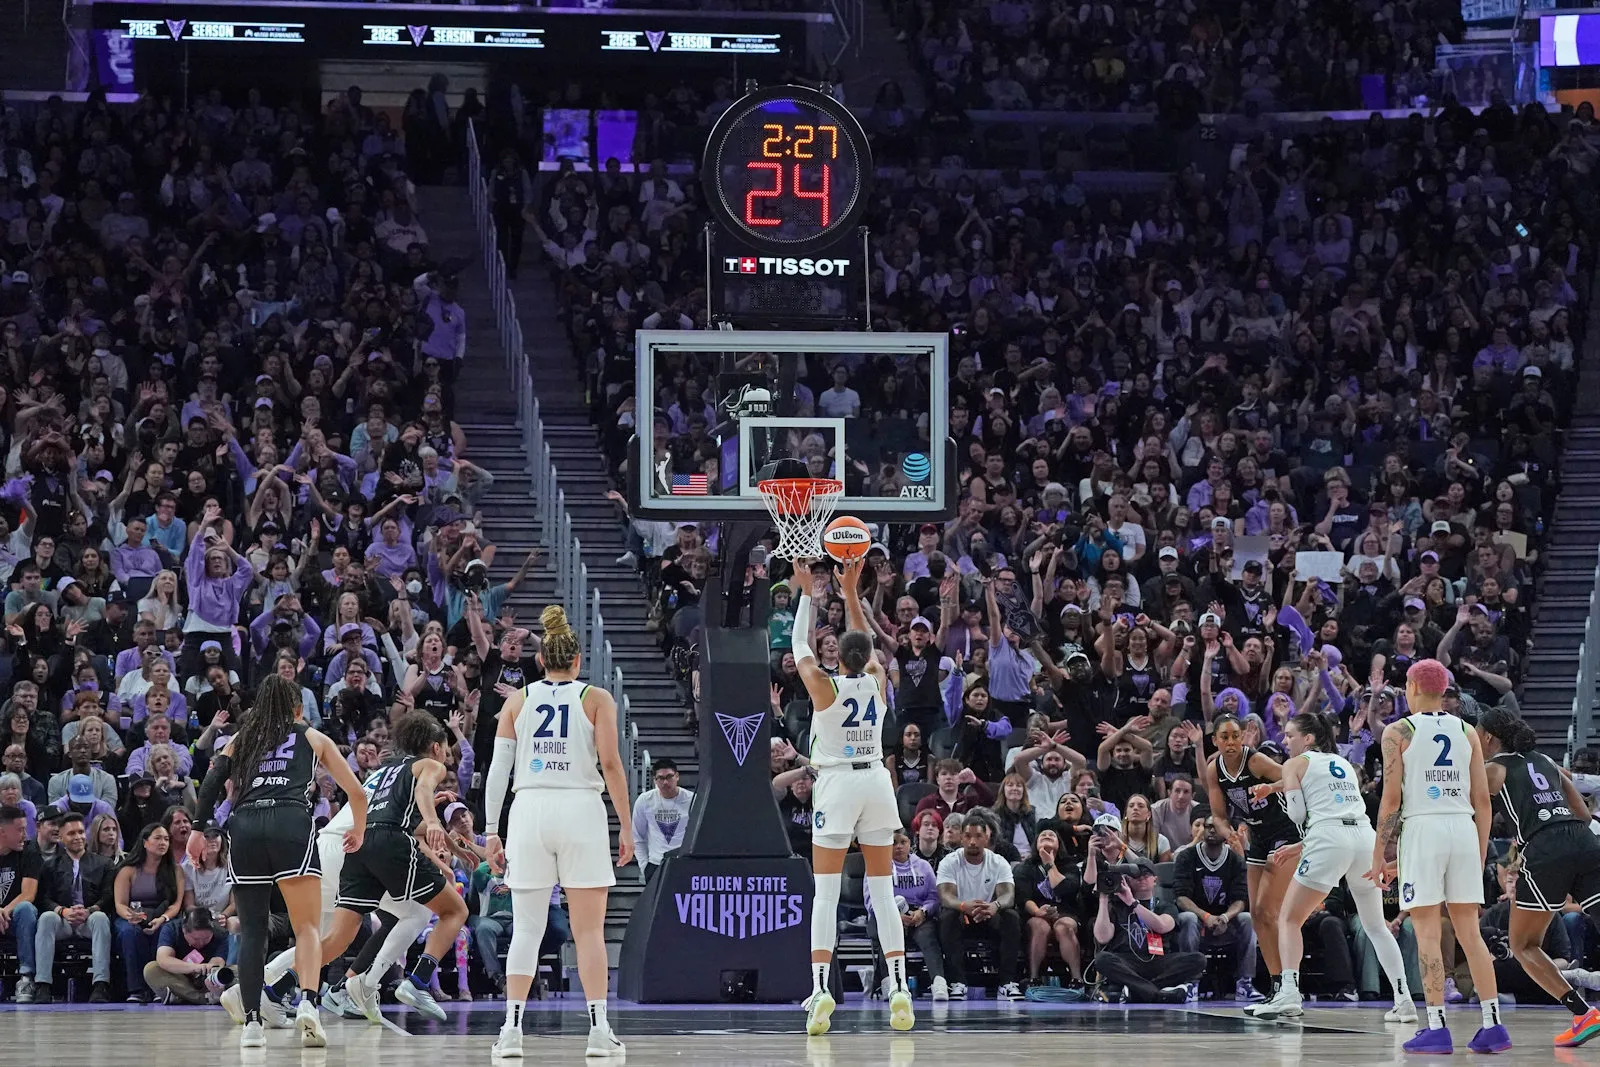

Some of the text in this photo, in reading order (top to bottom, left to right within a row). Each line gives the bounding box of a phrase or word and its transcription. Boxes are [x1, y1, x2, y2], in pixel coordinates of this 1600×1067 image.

[128, 22, 234, 37] 2025 SEASON
[371, 28, 475, 43] 2025 SEASON
[609, 33, 711, 48] 2025 SEASON
[1200, 127, 1217, 139] 22
[763, 123, 838, 159] 2:27
[746, 161, 830, 227] 24
[759, 257, 850, 276] TISSOT
[900, 485, 935, 499] AT&T
[832, 530, 864, 541] Wilson
[841, 695, 877, 727] 24
[532, 703, 569, 738] 21
[846, 730, 873, 742] COLLIER
[264, 732, 297, 760] 2
[533, 741, 567, 755] McBRIDE
[855, 746, 875, 755] AT&T
[1432, 733, 1453, 767] 2
[258, 760, 288, 773] BURTON
[544, 761, 571, 771] AT&T
[1329, 760, 1346, 779] 6
[264, 776, 291, 786] AT&T
[379, 763, 406, 791] 13
[1527, 762, 1550, 791] 6
[1533, 790, 1564, 805] CHARLES
[691, 876, 787, 892] GOLDEN STATE
[674, 893, 803, 940] VALKYRIES
